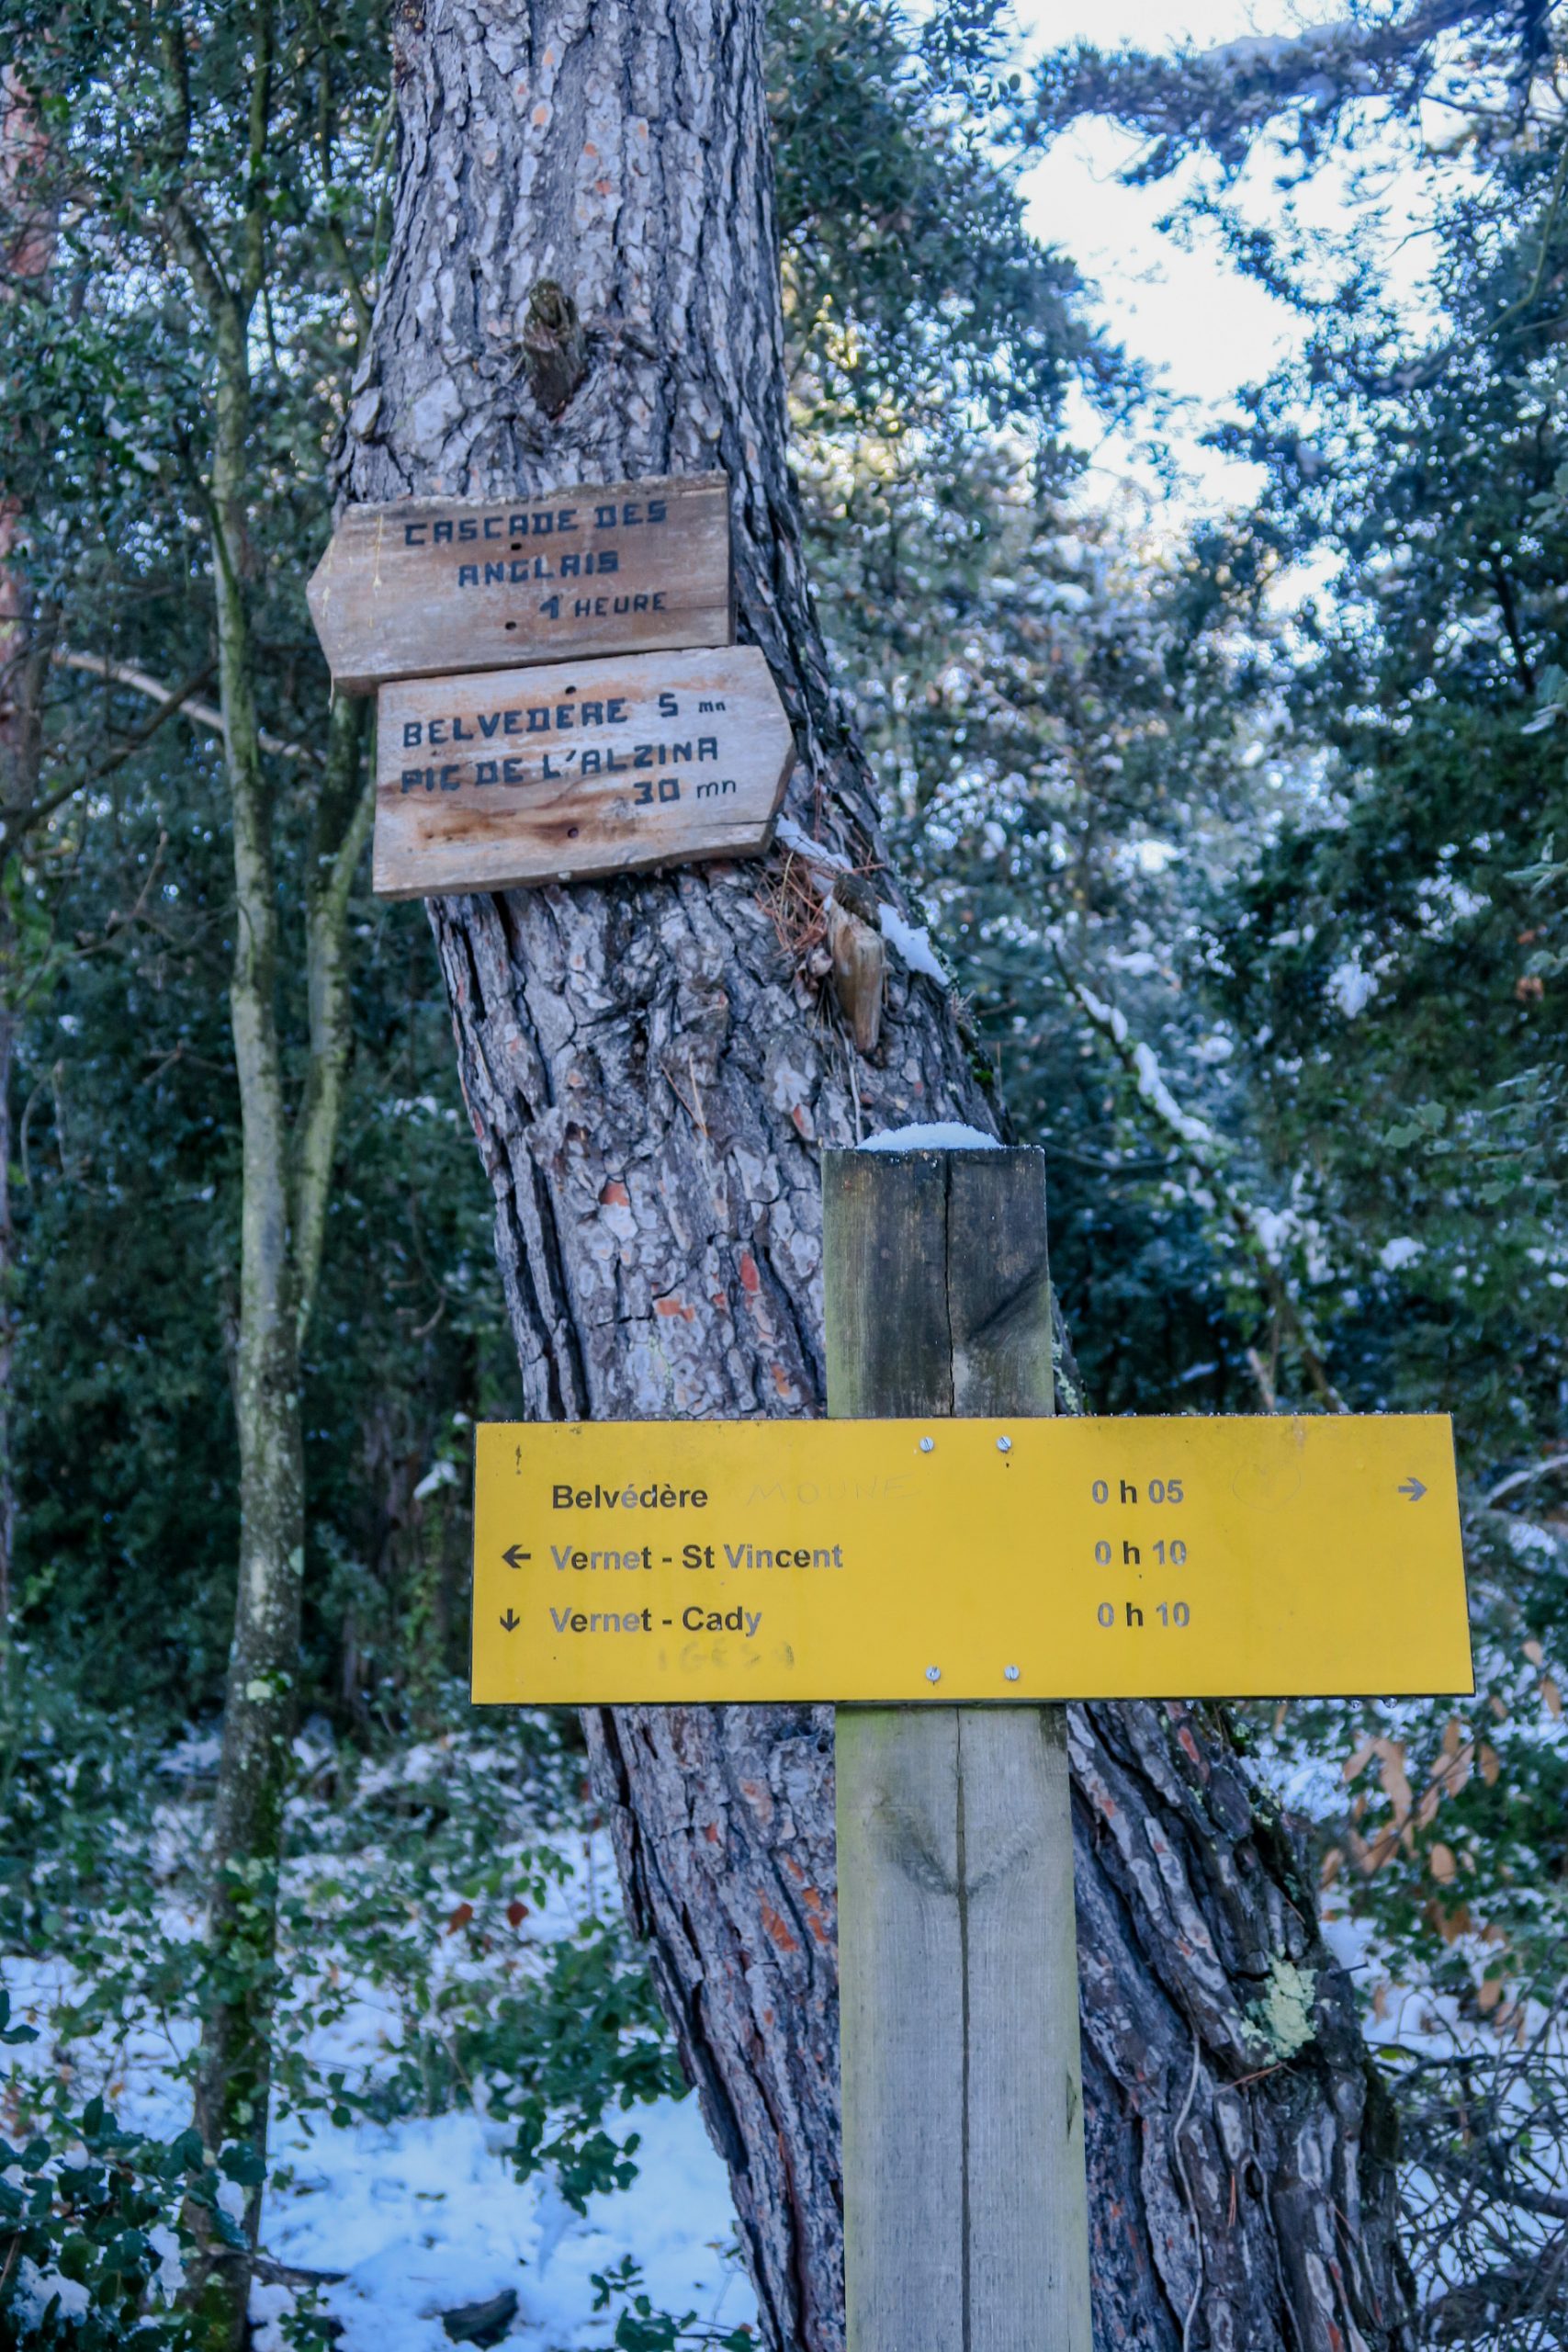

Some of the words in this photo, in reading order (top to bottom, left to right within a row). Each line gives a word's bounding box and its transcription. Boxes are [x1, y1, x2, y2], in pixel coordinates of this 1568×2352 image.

[404, 508, 578, 547] CASCADE
[593, 500, 667, 528] DES
[458, 551, 619, 587] ANGLAIS
[539, 594, 561, 619] 1
[574, 592, 667, 617] HEURE
[403, 697, 629, 748] BELVEDERE
[659, 693, 678, 717] 5
[698, 699, 726, 713] mn
[400, 764, 461, 794] PIC
[476, 760, 524, 786] DE
[543, 737, 718, 778] L'ALZINA
[634, 779, 680, 806] 30
[696, 778, 737, 799] mn
[552, 1484, 708, 1510] Belvédère
[1091, 1479, 1110, 1505] 0
[1120, 1480, 1138, 1504] h
[1148, 1478, 1184, 1504] 05
[550, 1544, 652, 1571] Vernet
[682, 1544, 716, 1570] St
[723, 1544, 843, 1569] Vincent
[1094, 1540, 1111, 1566] 0
[1122, 1540, 1141, 1566] h
[1152, 1540, 1188, 1566] 10
[549, 1607, 652, 1634] Vernet
[682, 1605, 762, 1637] Cady
[1098, 1602, 1115, 1628] 0
[1126, 1602, 1144, 1627] h
[1156, 1601, 1190, 1627] 10
